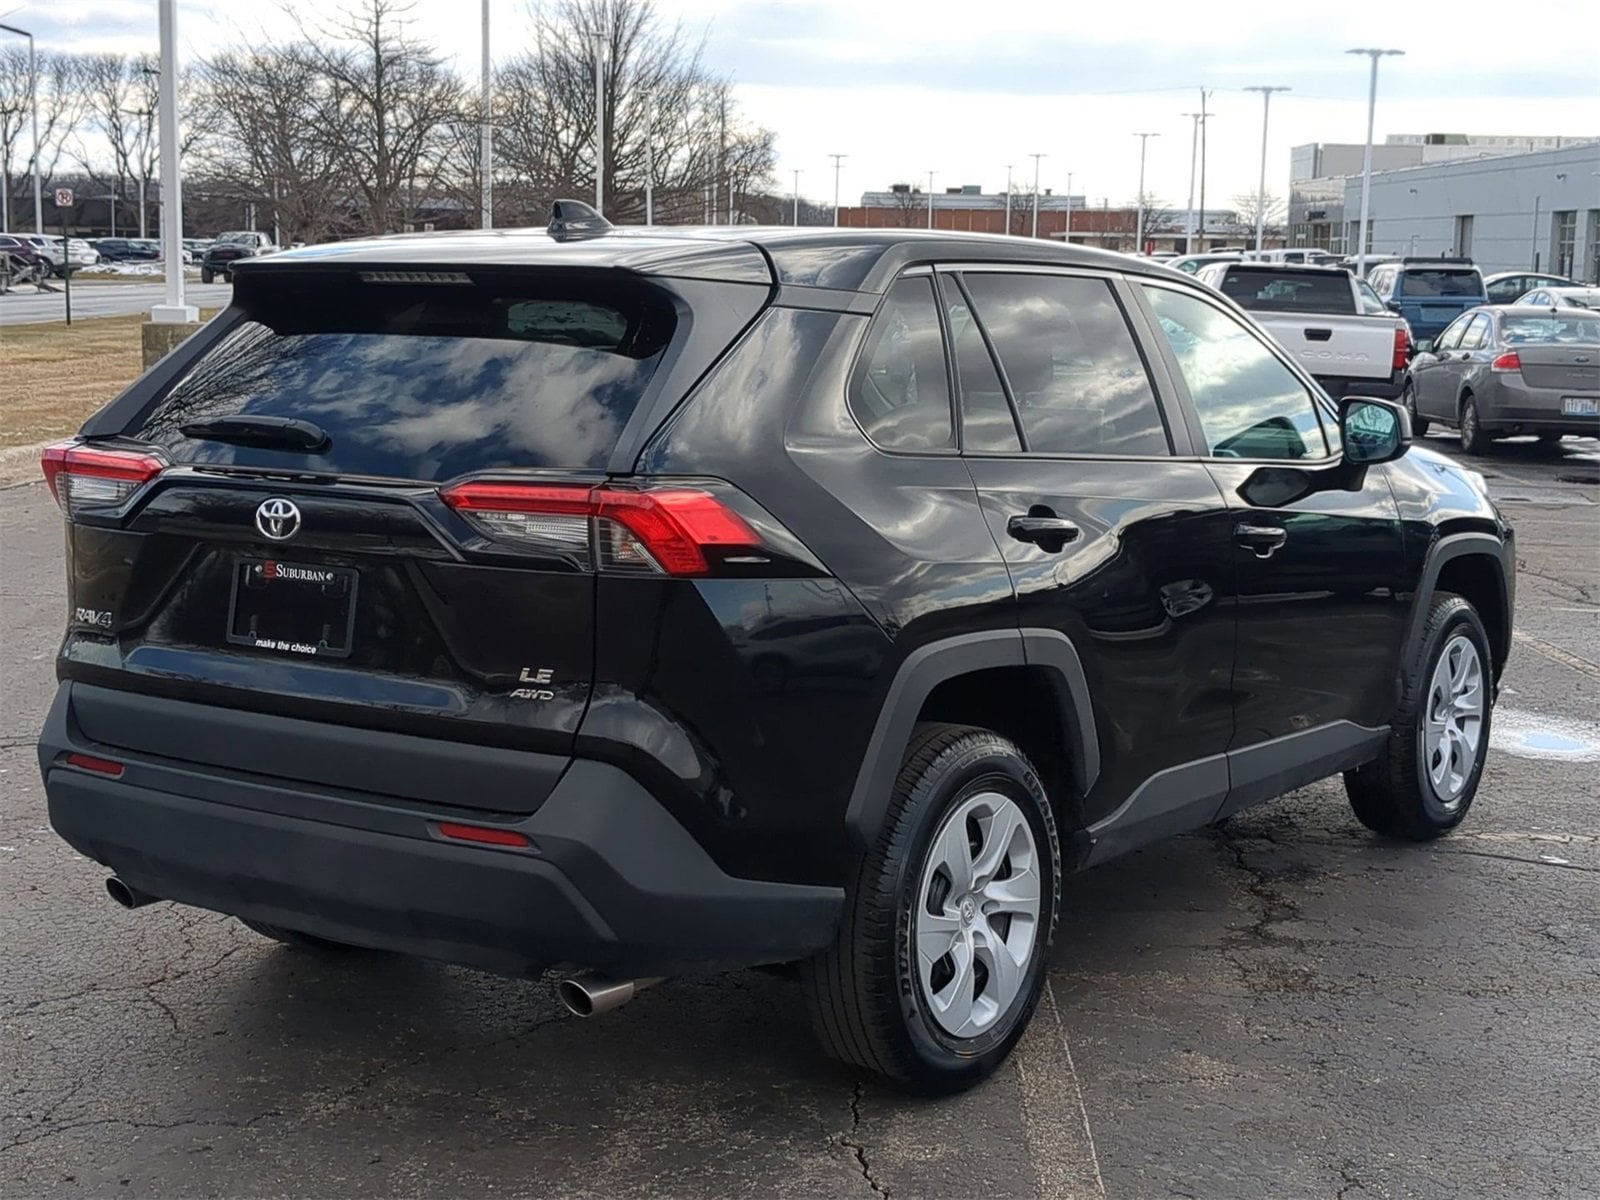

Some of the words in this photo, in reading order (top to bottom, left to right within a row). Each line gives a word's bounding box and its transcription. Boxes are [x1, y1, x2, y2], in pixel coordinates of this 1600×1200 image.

[1289, 349, 1369, 361] COMA
[276, 563, 325, 581] SUBURBAN
[76, 607, 112, 628] RAV4
[256, 639, 276, 649] make
[277, 640, 290, 651] the
[291, 643, 317, 654] choice
[519, 667, 554, 684] LE
[510, 688, 554, 700] AWD
